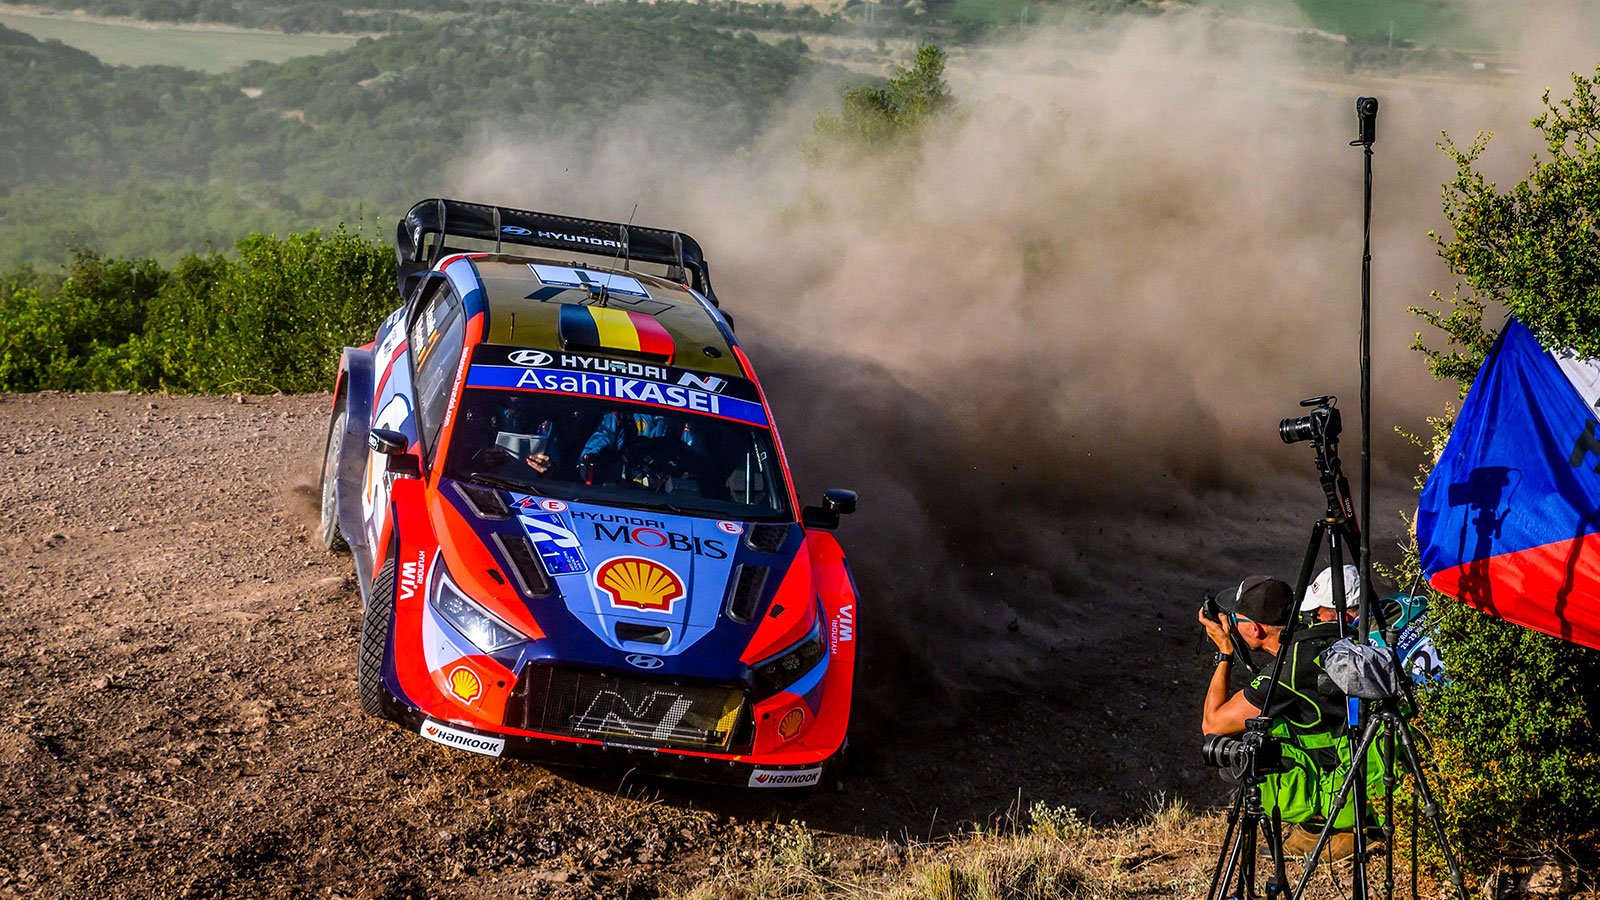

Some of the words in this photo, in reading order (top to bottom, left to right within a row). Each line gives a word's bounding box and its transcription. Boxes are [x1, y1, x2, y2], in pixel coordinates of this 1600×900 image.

[538, 230, 627, 249] HYUNDAI
[561, 354, 667, 380] HYUNDAI
[548, 501, 560, 510] E
[571, 511, 666, 529] HYUNDAI
[593, 522, 728, 560] MOBIS
[725, 523, 737, 532] E
[400, 561, 419, 601] WIA
[416, 550, 426, 585] HYUNDAI
[831, 619, 839, 655] HYUNDAI
[836, 604, 853, 642] WIA
